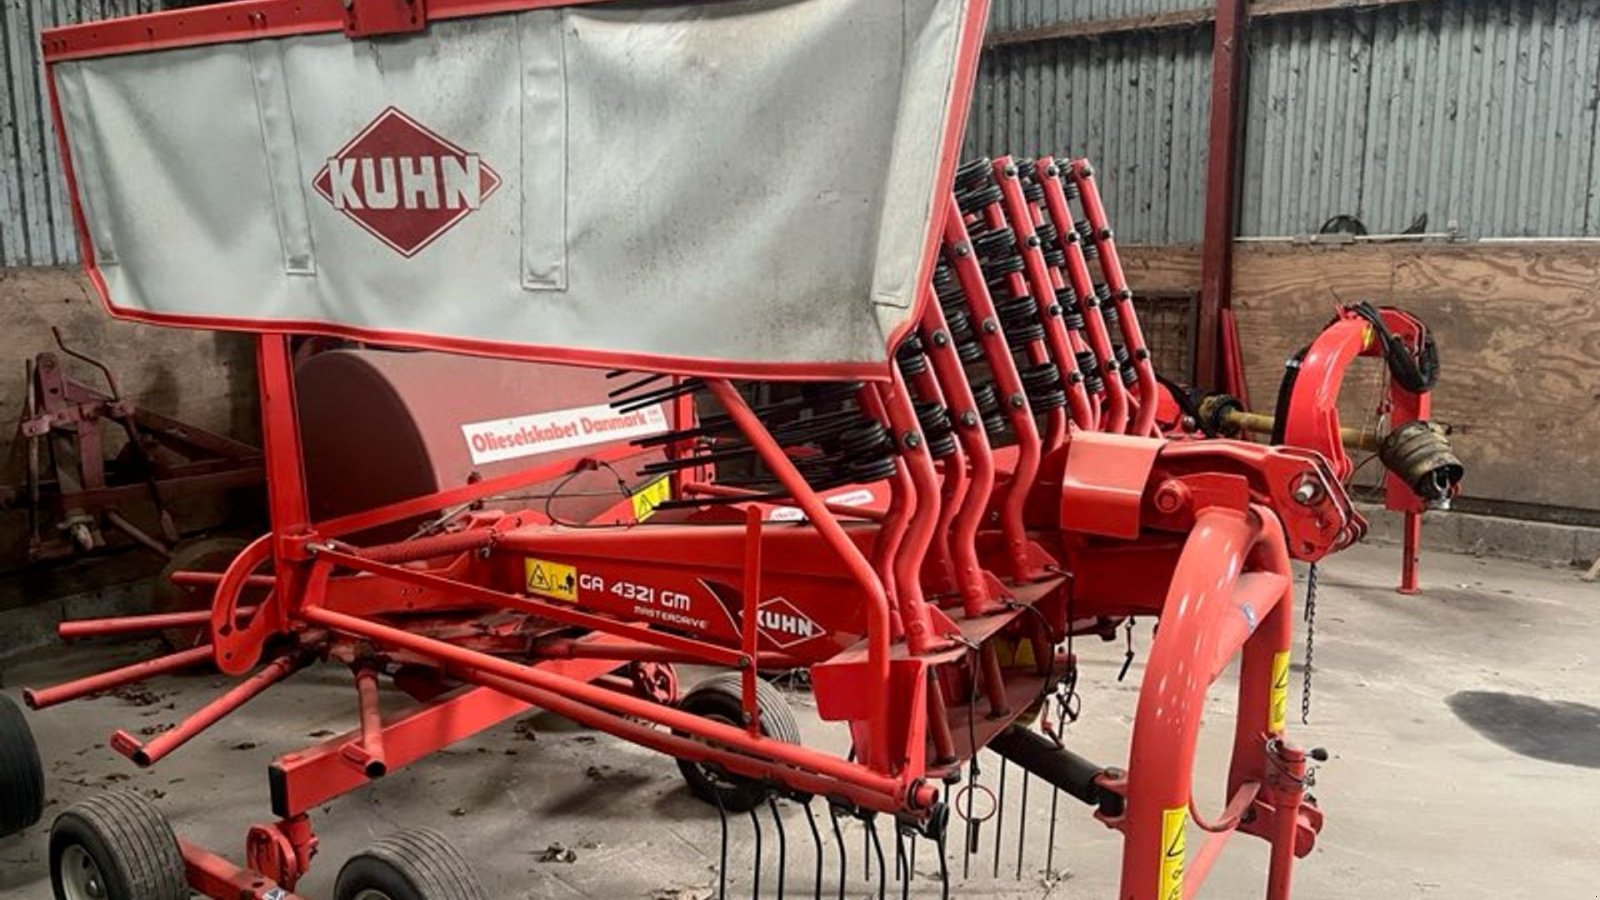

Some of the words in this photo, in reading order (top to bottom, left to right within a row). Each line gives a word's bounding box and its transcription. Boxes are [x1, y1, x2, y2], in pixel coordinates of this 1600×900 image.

[328, 154, 480, 210] KUHN
[472, 422, 579, 453] Olieselskabet
[580, 411, 648, 435] Danmark
[579, 573, 604, 592] GA
[611, 582, 655, 603] 4321
[661, 590, 690, 611] GM
[634, 605, 707, 629] MASTERDRIVE
